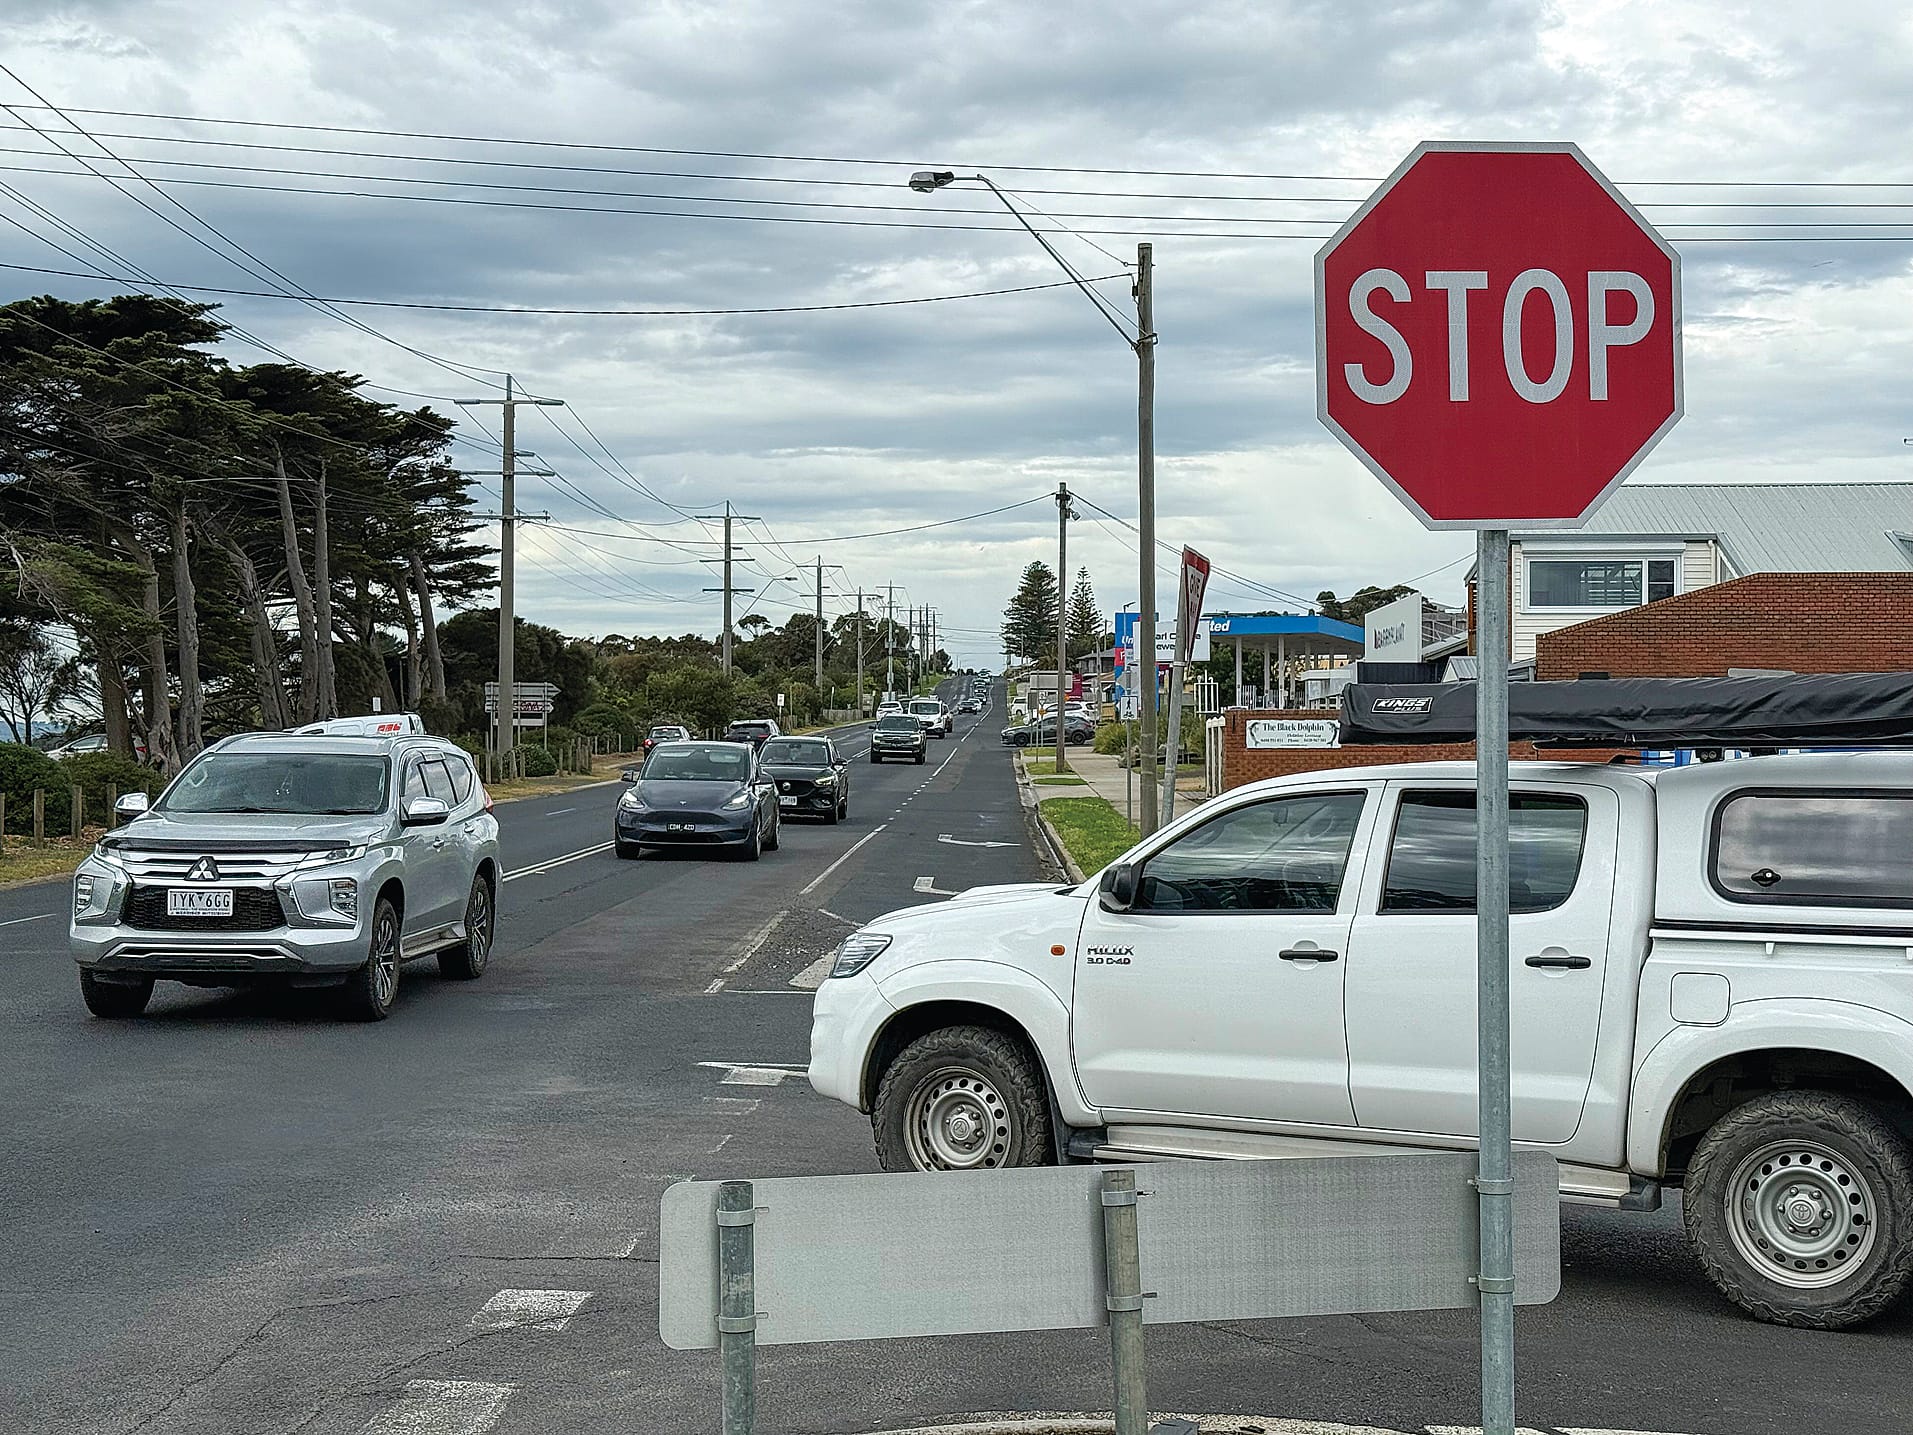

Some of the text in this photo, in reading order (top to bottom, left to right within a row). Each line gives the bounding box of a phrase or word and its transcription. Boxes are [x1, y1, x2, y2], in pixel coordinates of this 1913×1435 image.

[1344, 268, 1656, 405] STOP
[1209, 620, 1231, 632] ted
[1376, 699, 1429, 708] KINGS
[1262, 722, 1325, 733] The Black Dolphin
[1087, 944, 1135, 956] HILUX
